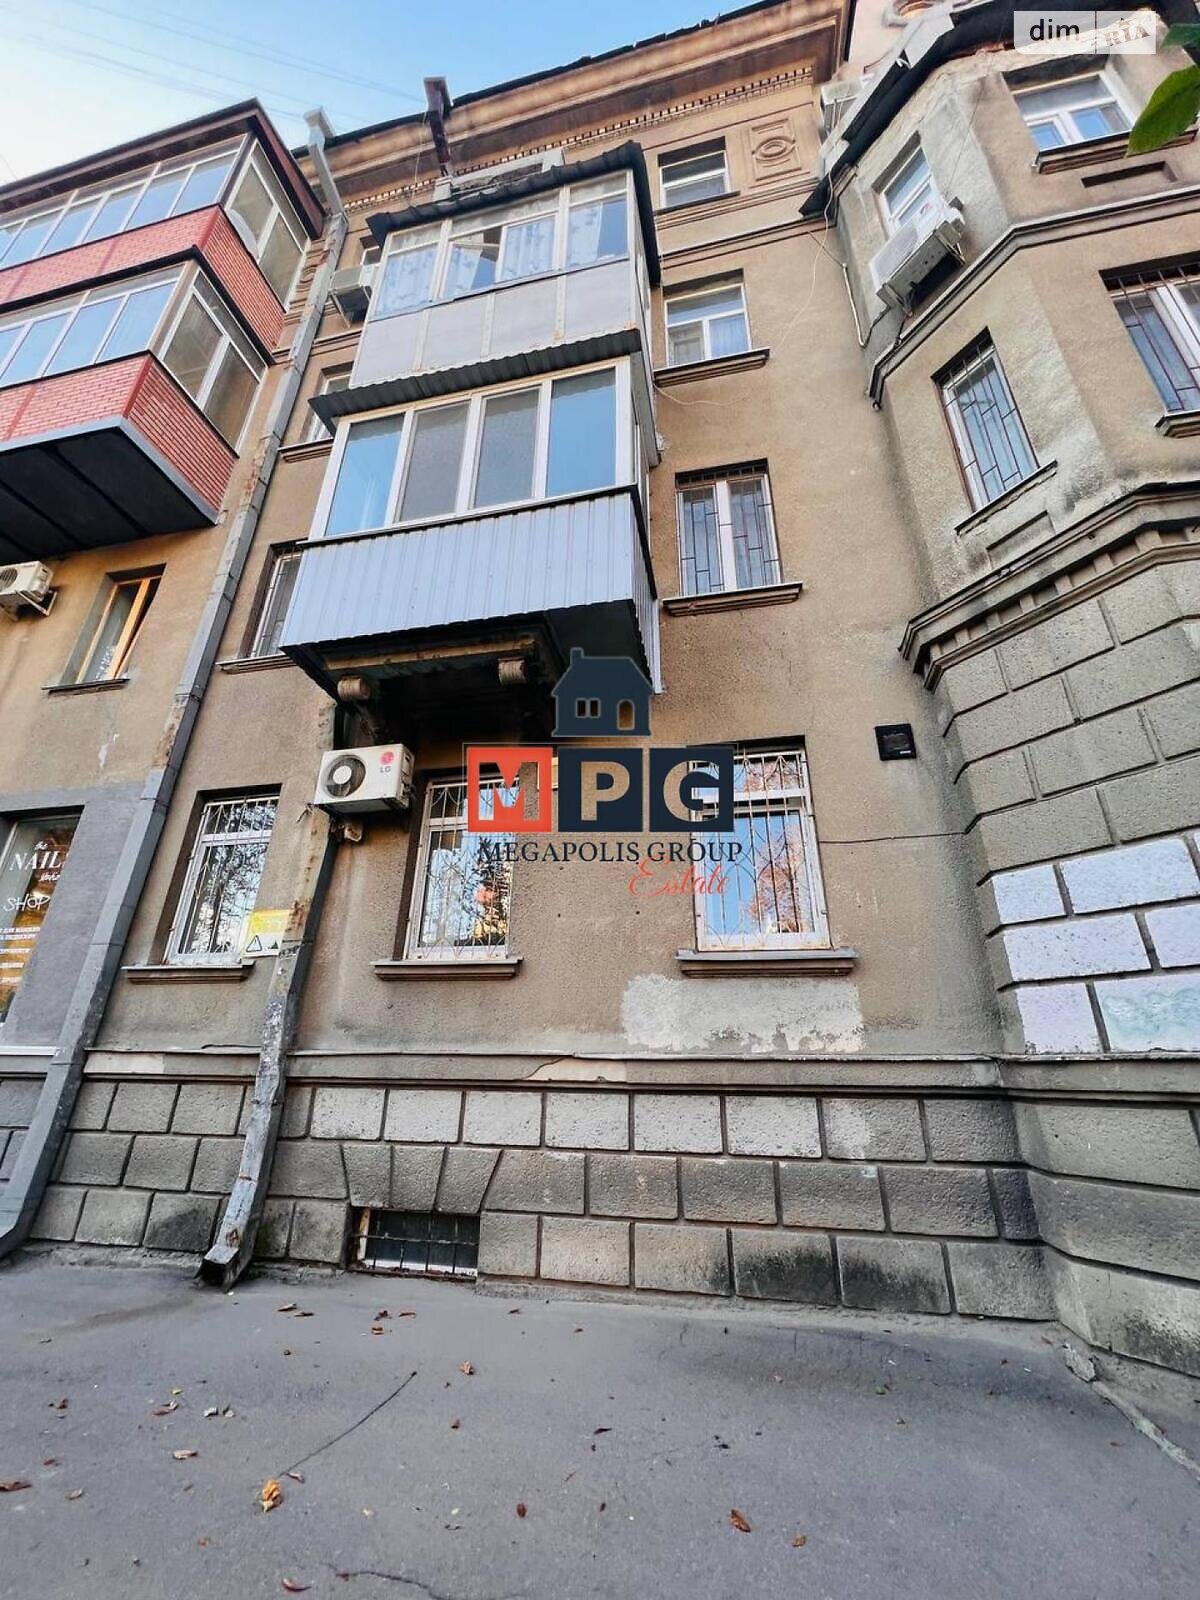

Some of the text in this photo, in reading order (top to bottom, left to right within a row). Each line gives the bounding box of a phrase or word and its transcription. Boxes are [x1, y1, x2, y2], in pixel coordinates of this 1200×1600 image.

[379, 766, 391, 774] LG
[9, 851, 66, 870] NAIL
[3, 894, 51, 911] SHOP
